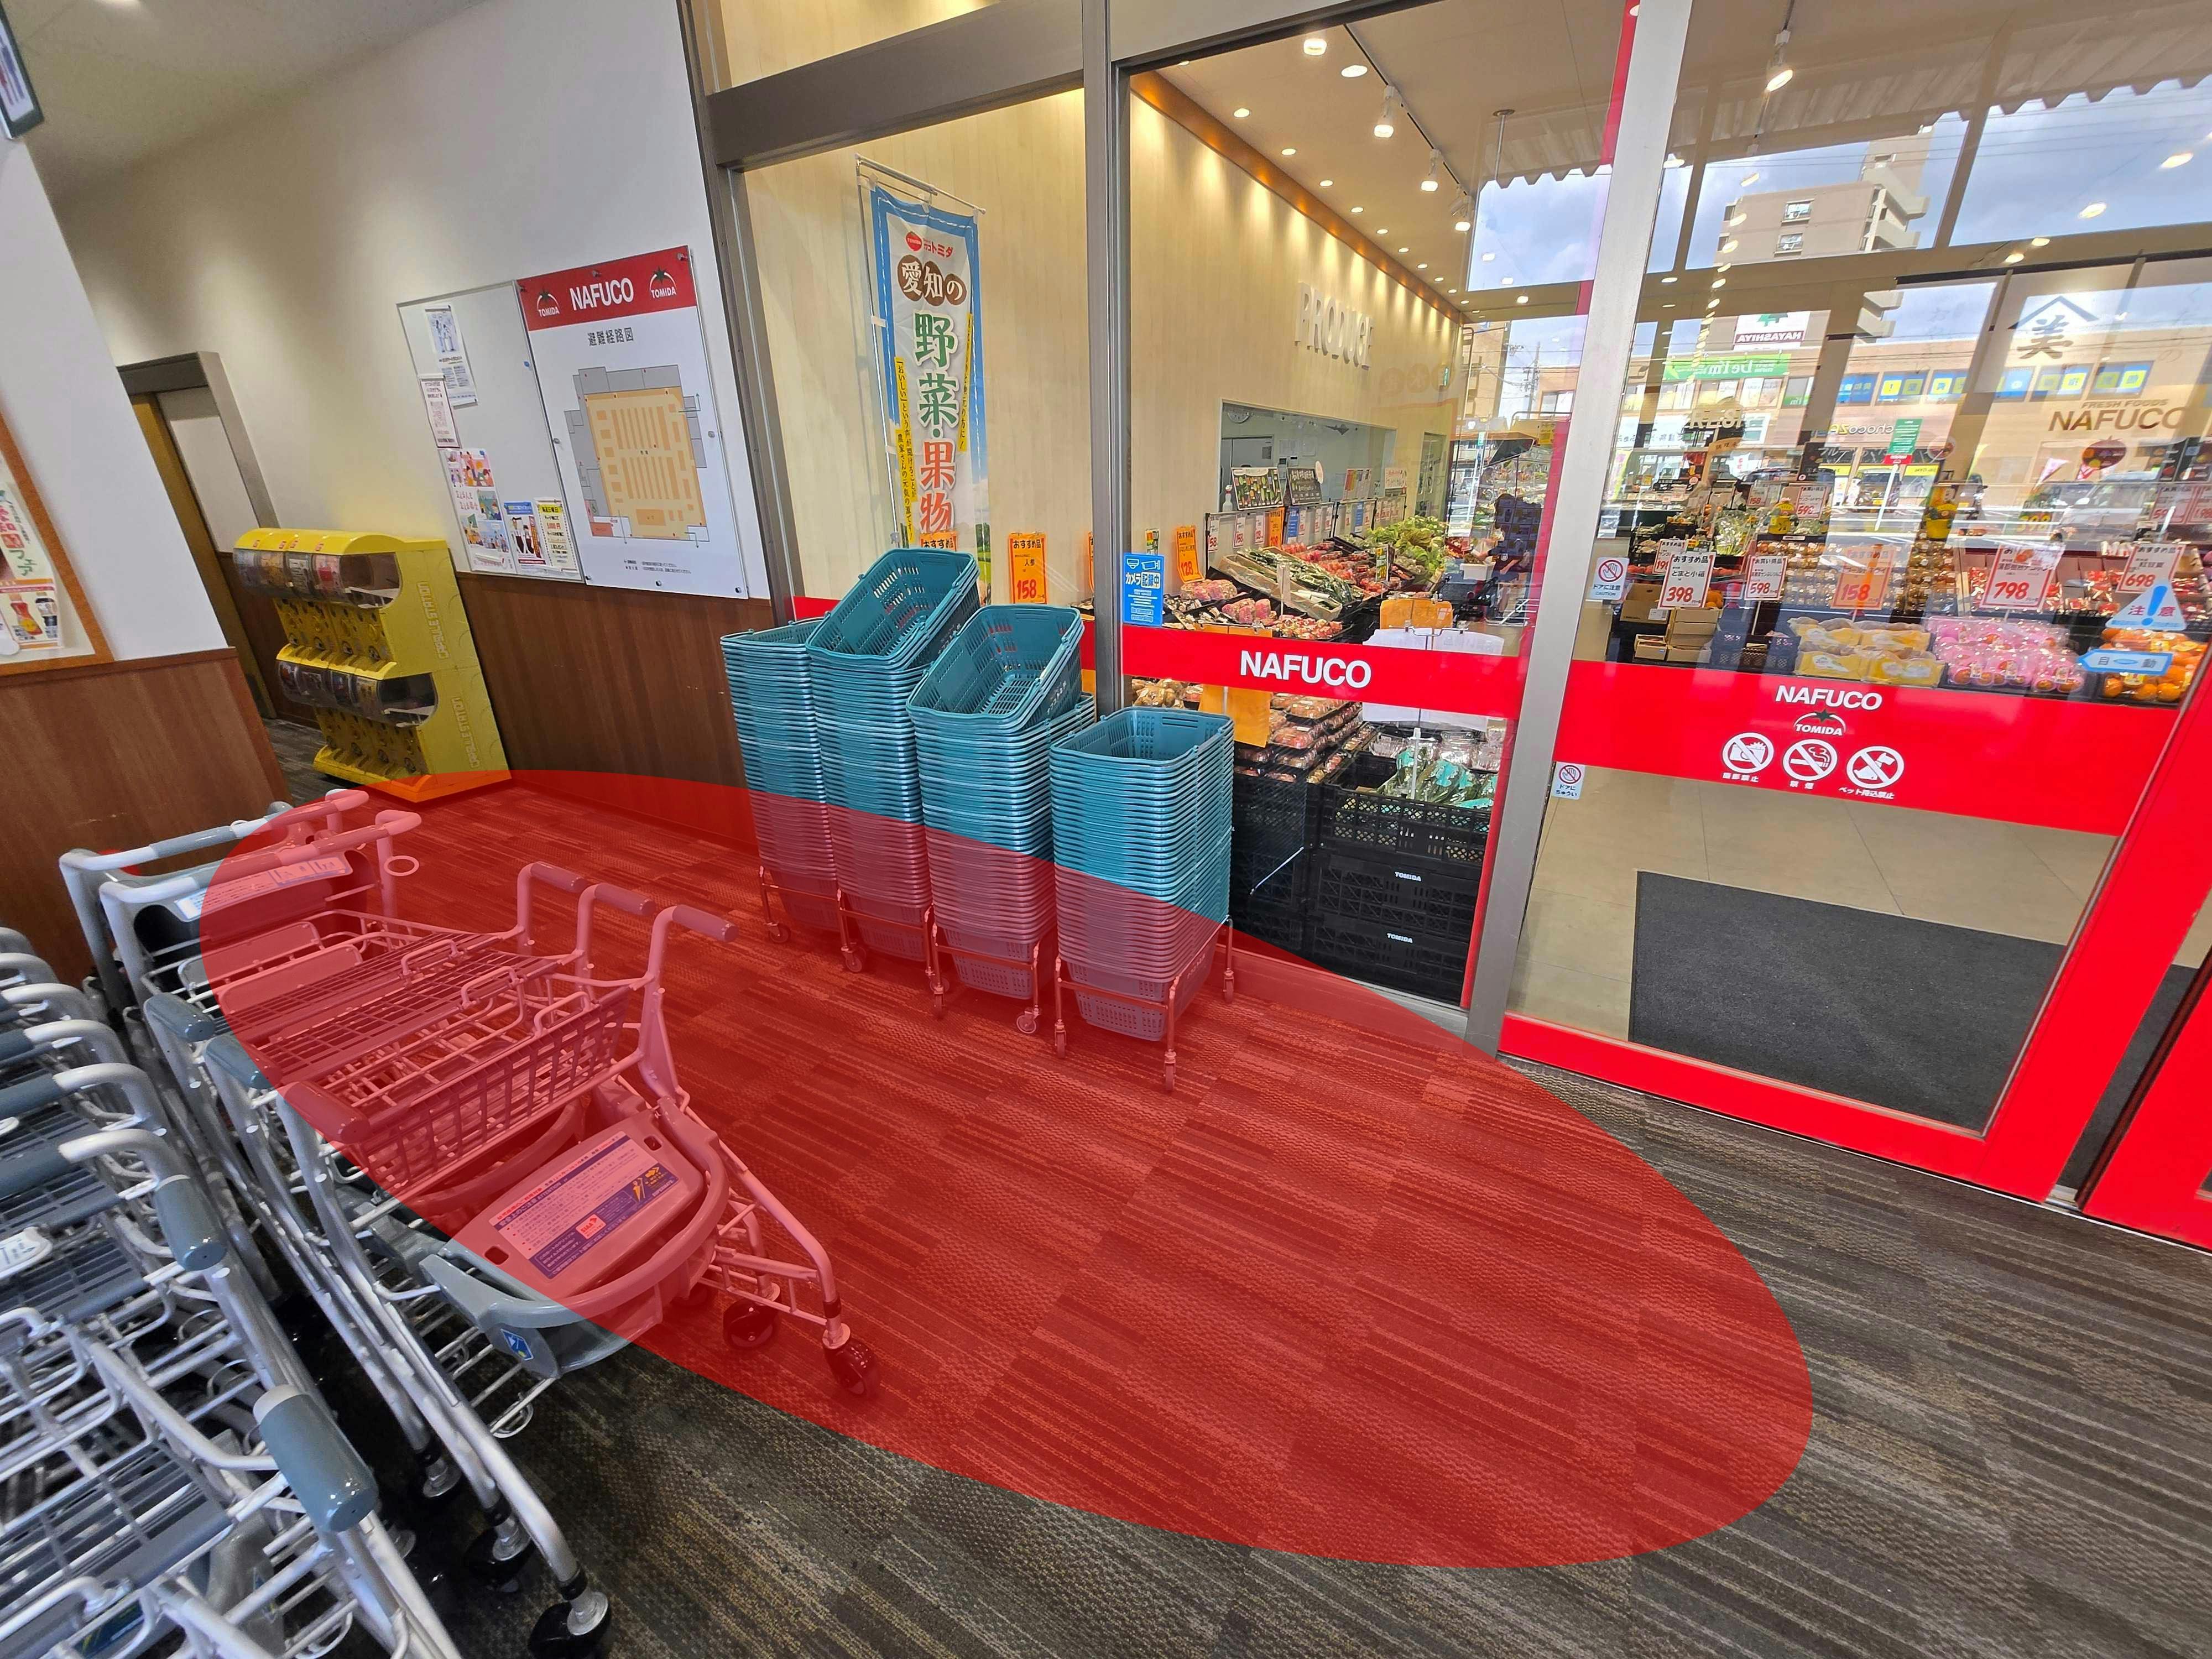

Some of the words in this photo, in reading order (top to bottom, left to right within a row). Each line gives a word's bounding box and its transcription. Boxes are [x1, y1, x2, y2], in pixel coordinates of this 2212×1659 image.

[902, 261, 963, 300] 愛知の
[569, 278, 634, 311] NAFUCO
[651, 286, 676, 299] TOMIDA
[538, 308, 560, 317] TOMIDA
[1295, 281, 1373, 367] PRODUCE
[587, 327, 634, 347] 避難経路図
[2081, 400, 2121, 409] FRESH
[2124, 399, 2168, 408] FOODS
[914, 312, 958, 532] 野菜・果物
[2048, 406, 2187, 431] NAFUCO
[1013, 539, 1041, 549] おすすめ品
[1673, 555, 1709, 564] おすすめ品
[1181, 561, 1194, 576] 128
[2125, 574, 2156, 587] 698
[1017, 579, 1037, 600] 158
[1666, 587, 1694, 602] 398
[1750, 582, 1771, 594] 598
[1840, 583, 1870, 602] 158
[1994, 581, 2030, 600] 798
[2127, 605, 2176, 617] 注意
[1240, 650, 1371, 688] NAFUCO
[2098, 656, 2157, 669] 自動
[1775, 685, 1882, 711] NAFUCO
[1796, 723, 1843, 736] TOMIDA
[1722, 772, 1759, 783] 撮影禁止
[1790, 780, 1815, 790] 禁煙
[1838, 786, 1895, 800] ペット持込禁止
[1395, 872, 1422, 881] TOMIDA
[1387, 933, 1413, 943] TOMIDA
[536, 1181, 562, 1202] ATTENTION
[580, 1221, 594, 1233] SIAA
